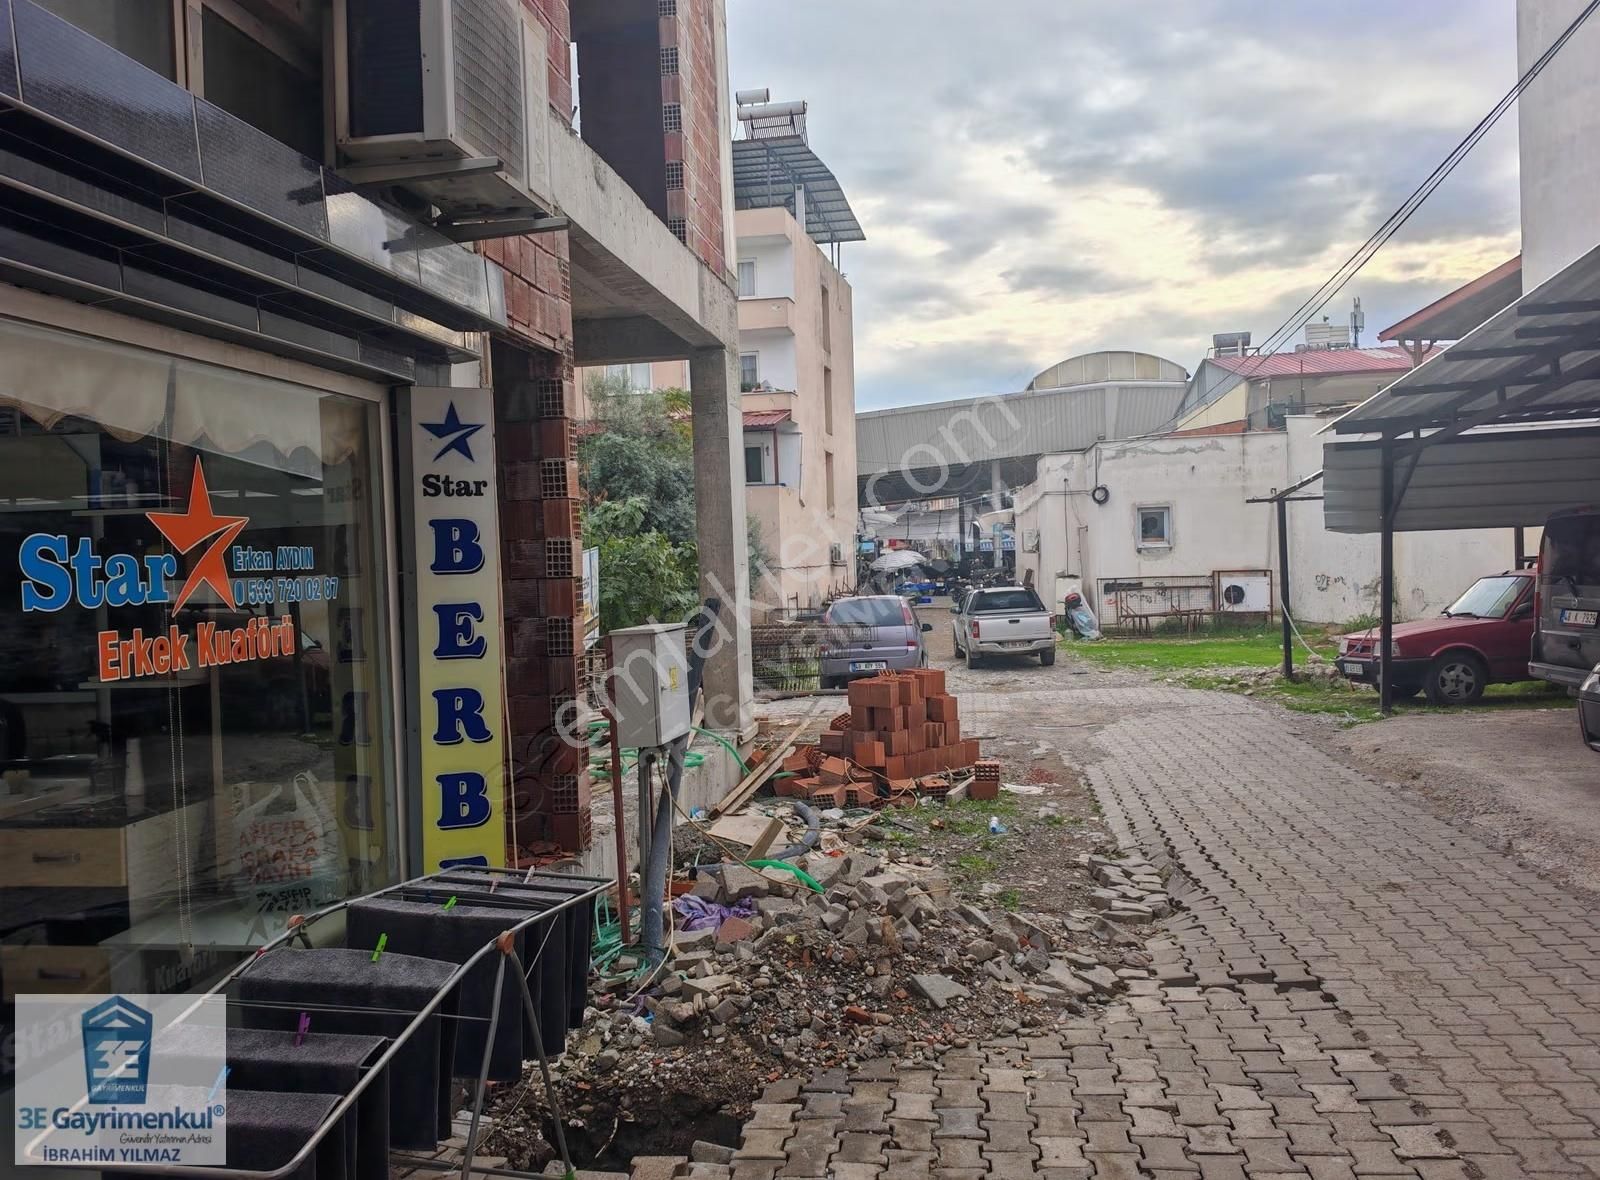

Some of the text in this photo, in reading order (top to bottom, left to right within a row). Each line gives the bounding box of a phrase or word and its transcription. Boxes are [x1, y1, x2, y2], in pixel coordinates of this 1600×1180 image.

[422, 473, 488, 497] Star
[19, 533, 178, 612] Star
[232, 545, 314, 571] Erkan AYDIN
[234, 576, 339, 606] 0 533 720 02 87
[98, 614, 296, 682] Erkek Kuaförü
[428, 518, 494, 875] BERB
